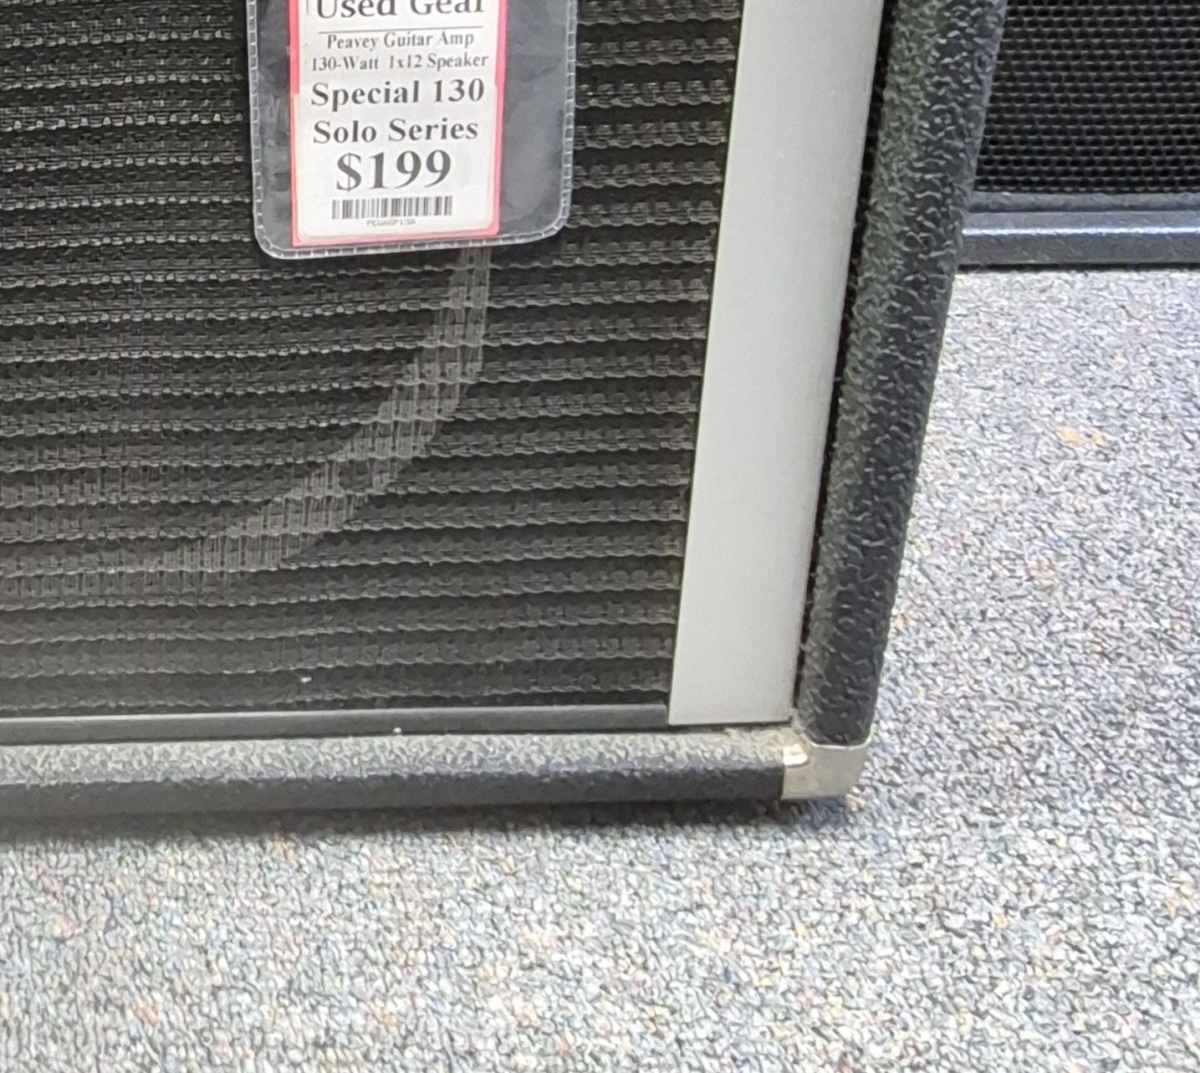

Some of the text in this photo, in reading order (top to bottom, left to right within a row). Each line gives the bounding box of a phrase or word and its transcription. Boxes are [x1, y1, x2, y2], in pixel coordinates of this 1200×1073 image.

[327, 30, 474, 52] Peavey Guitar Amp
[312, 52, 490, 72] 130-Watt 1x12 Speaker
[311, 78, 485, 112] Special 130
[313, 117, 479, 144] Solo Series
[336, 149, 452, 192] $199
